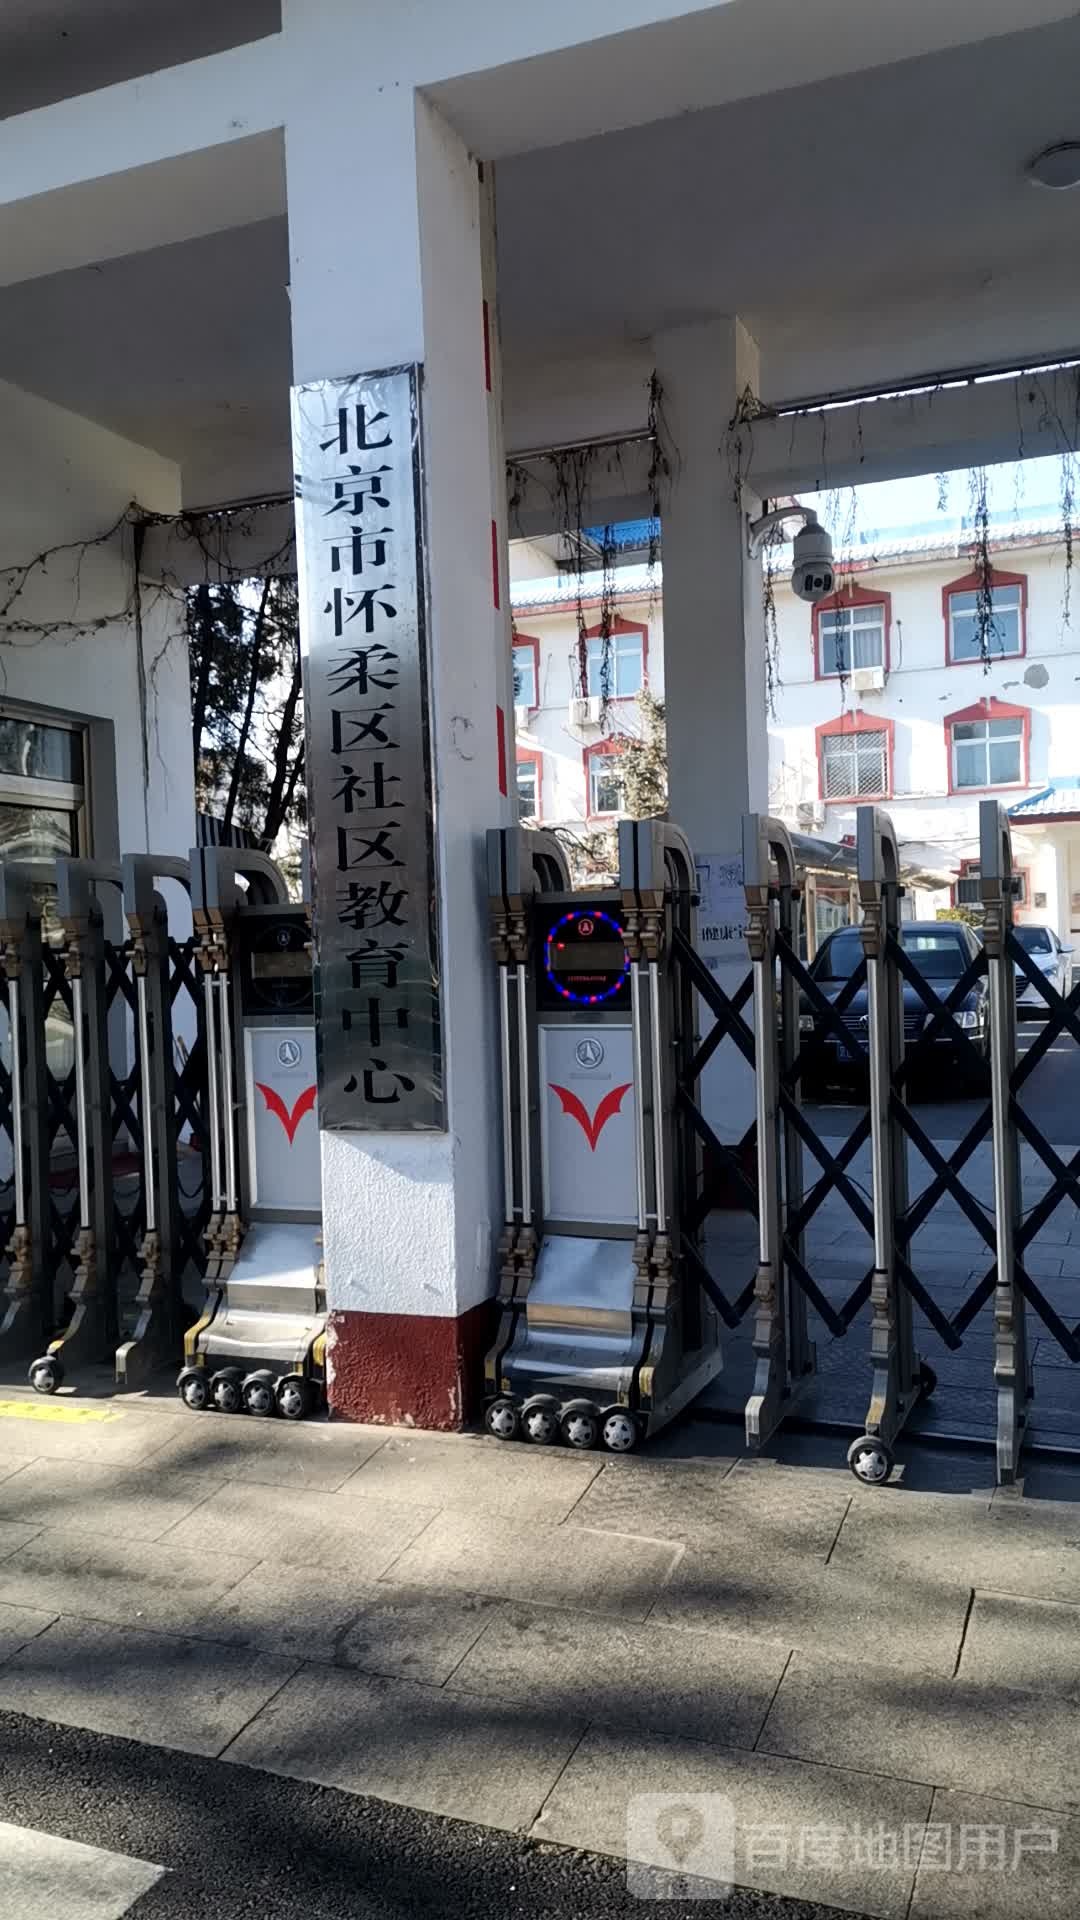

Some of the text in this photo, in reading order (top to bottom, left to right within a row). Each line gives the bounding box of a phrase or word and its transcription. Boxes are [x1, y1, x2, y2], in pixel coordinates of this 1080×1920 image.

[318, 404, 415, 1103] 北京市怀柔区社区教育中心
